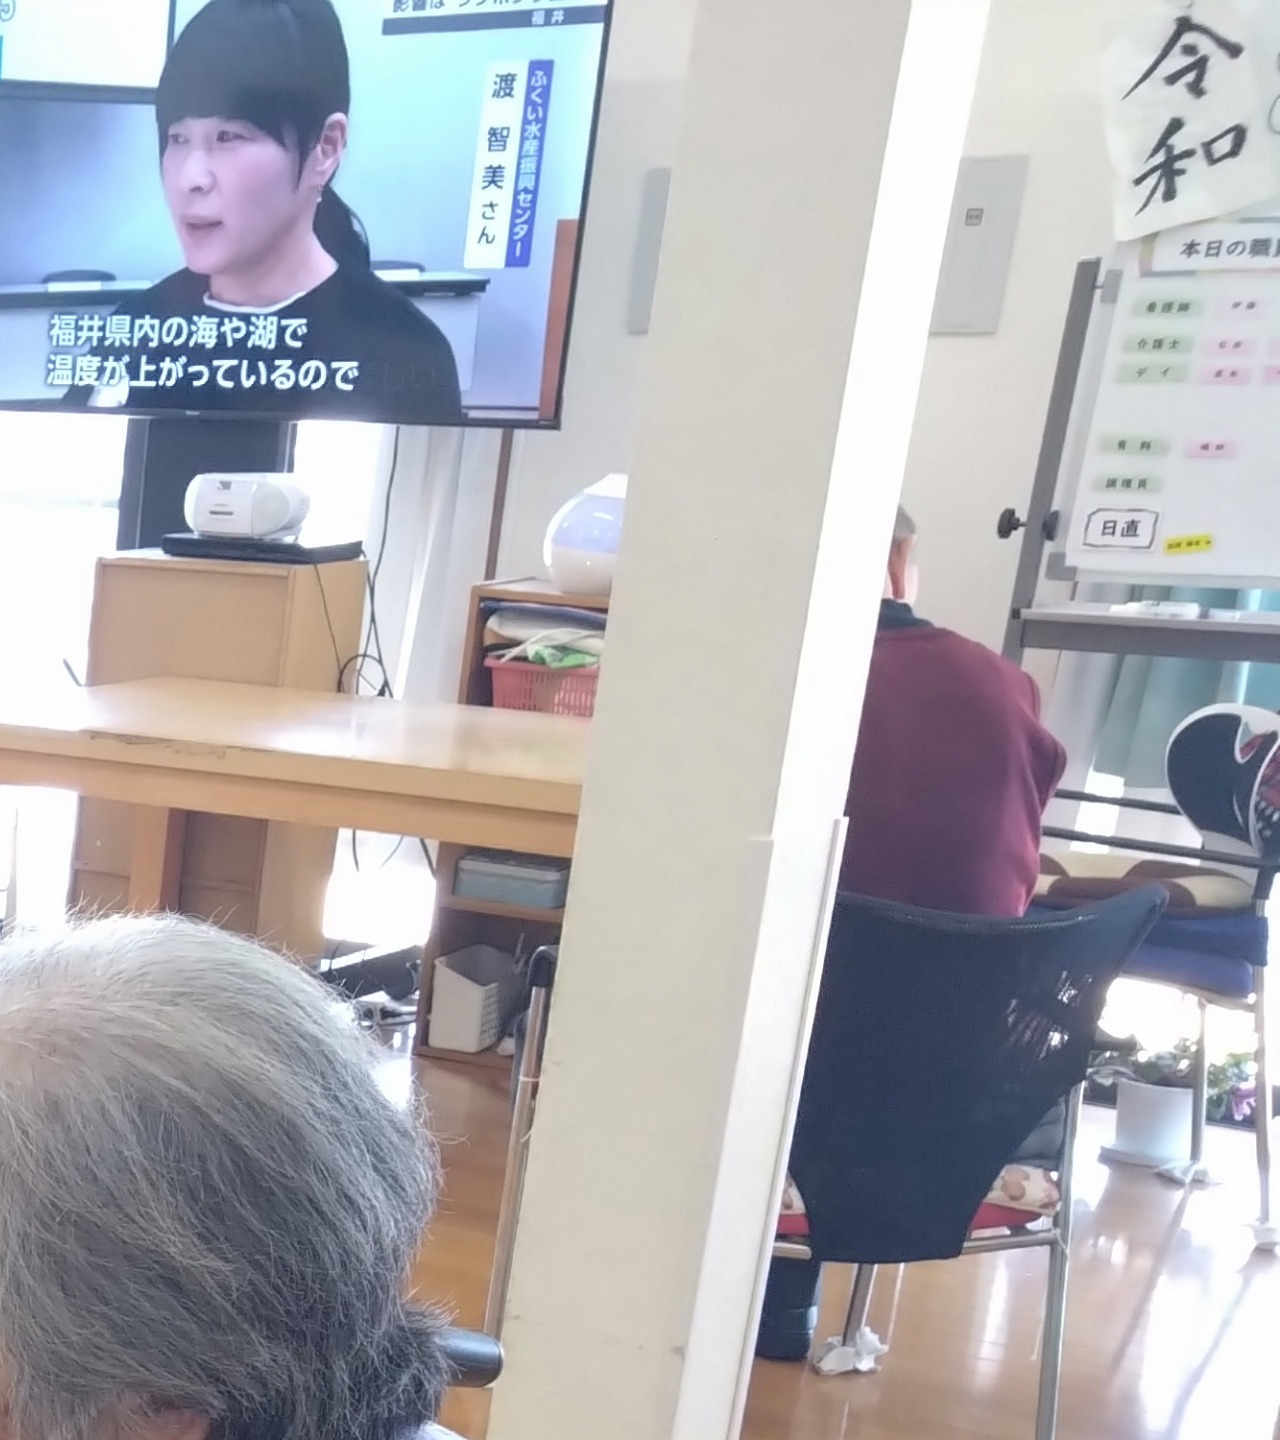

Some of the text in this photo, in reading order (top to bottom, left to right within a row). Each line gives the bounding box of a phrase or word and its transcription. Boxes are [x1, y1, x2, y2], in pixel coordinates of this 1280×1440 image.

[1121, 14, 1248, 218] 令和
[513, 69, 548, 258] ふくい水産振興センター
[49, 314, 308, 350] 福井県内の海や湖で
[46, 353, 360, 392] 温度が上がっているので
[1101, 518, 1141, 538] 日直
